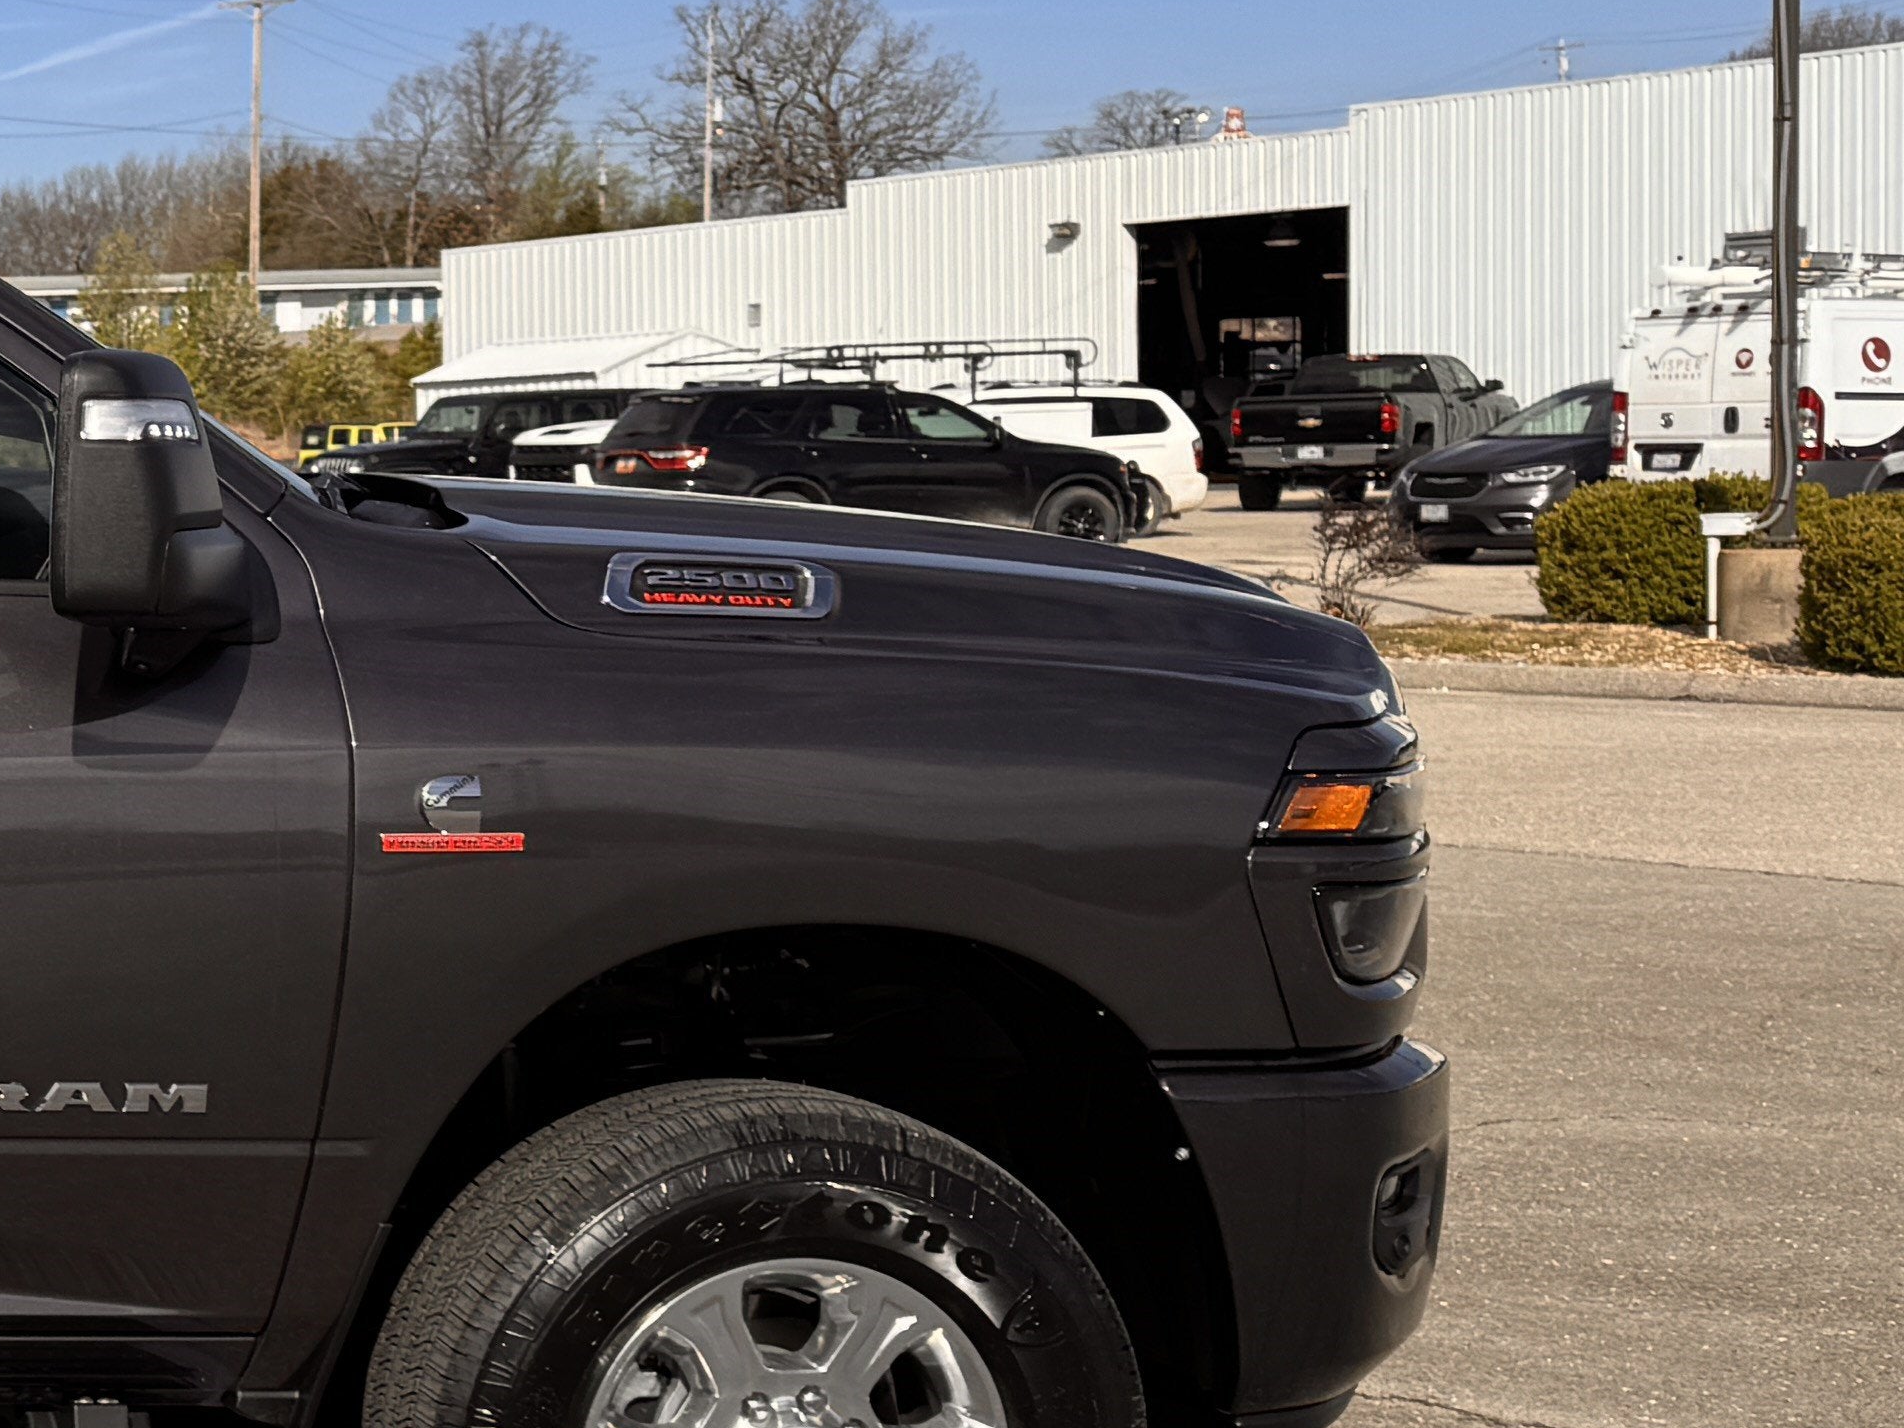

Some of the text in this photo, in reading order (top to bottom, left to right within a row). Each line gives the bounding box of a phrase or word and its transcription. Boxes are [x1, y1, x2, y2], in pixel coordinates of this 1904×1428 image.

[644, 569, 793, 590] 2500
[644, 592, 792, 607] HEAVY DUTY
[425, 774, 476, 807] Cummins
